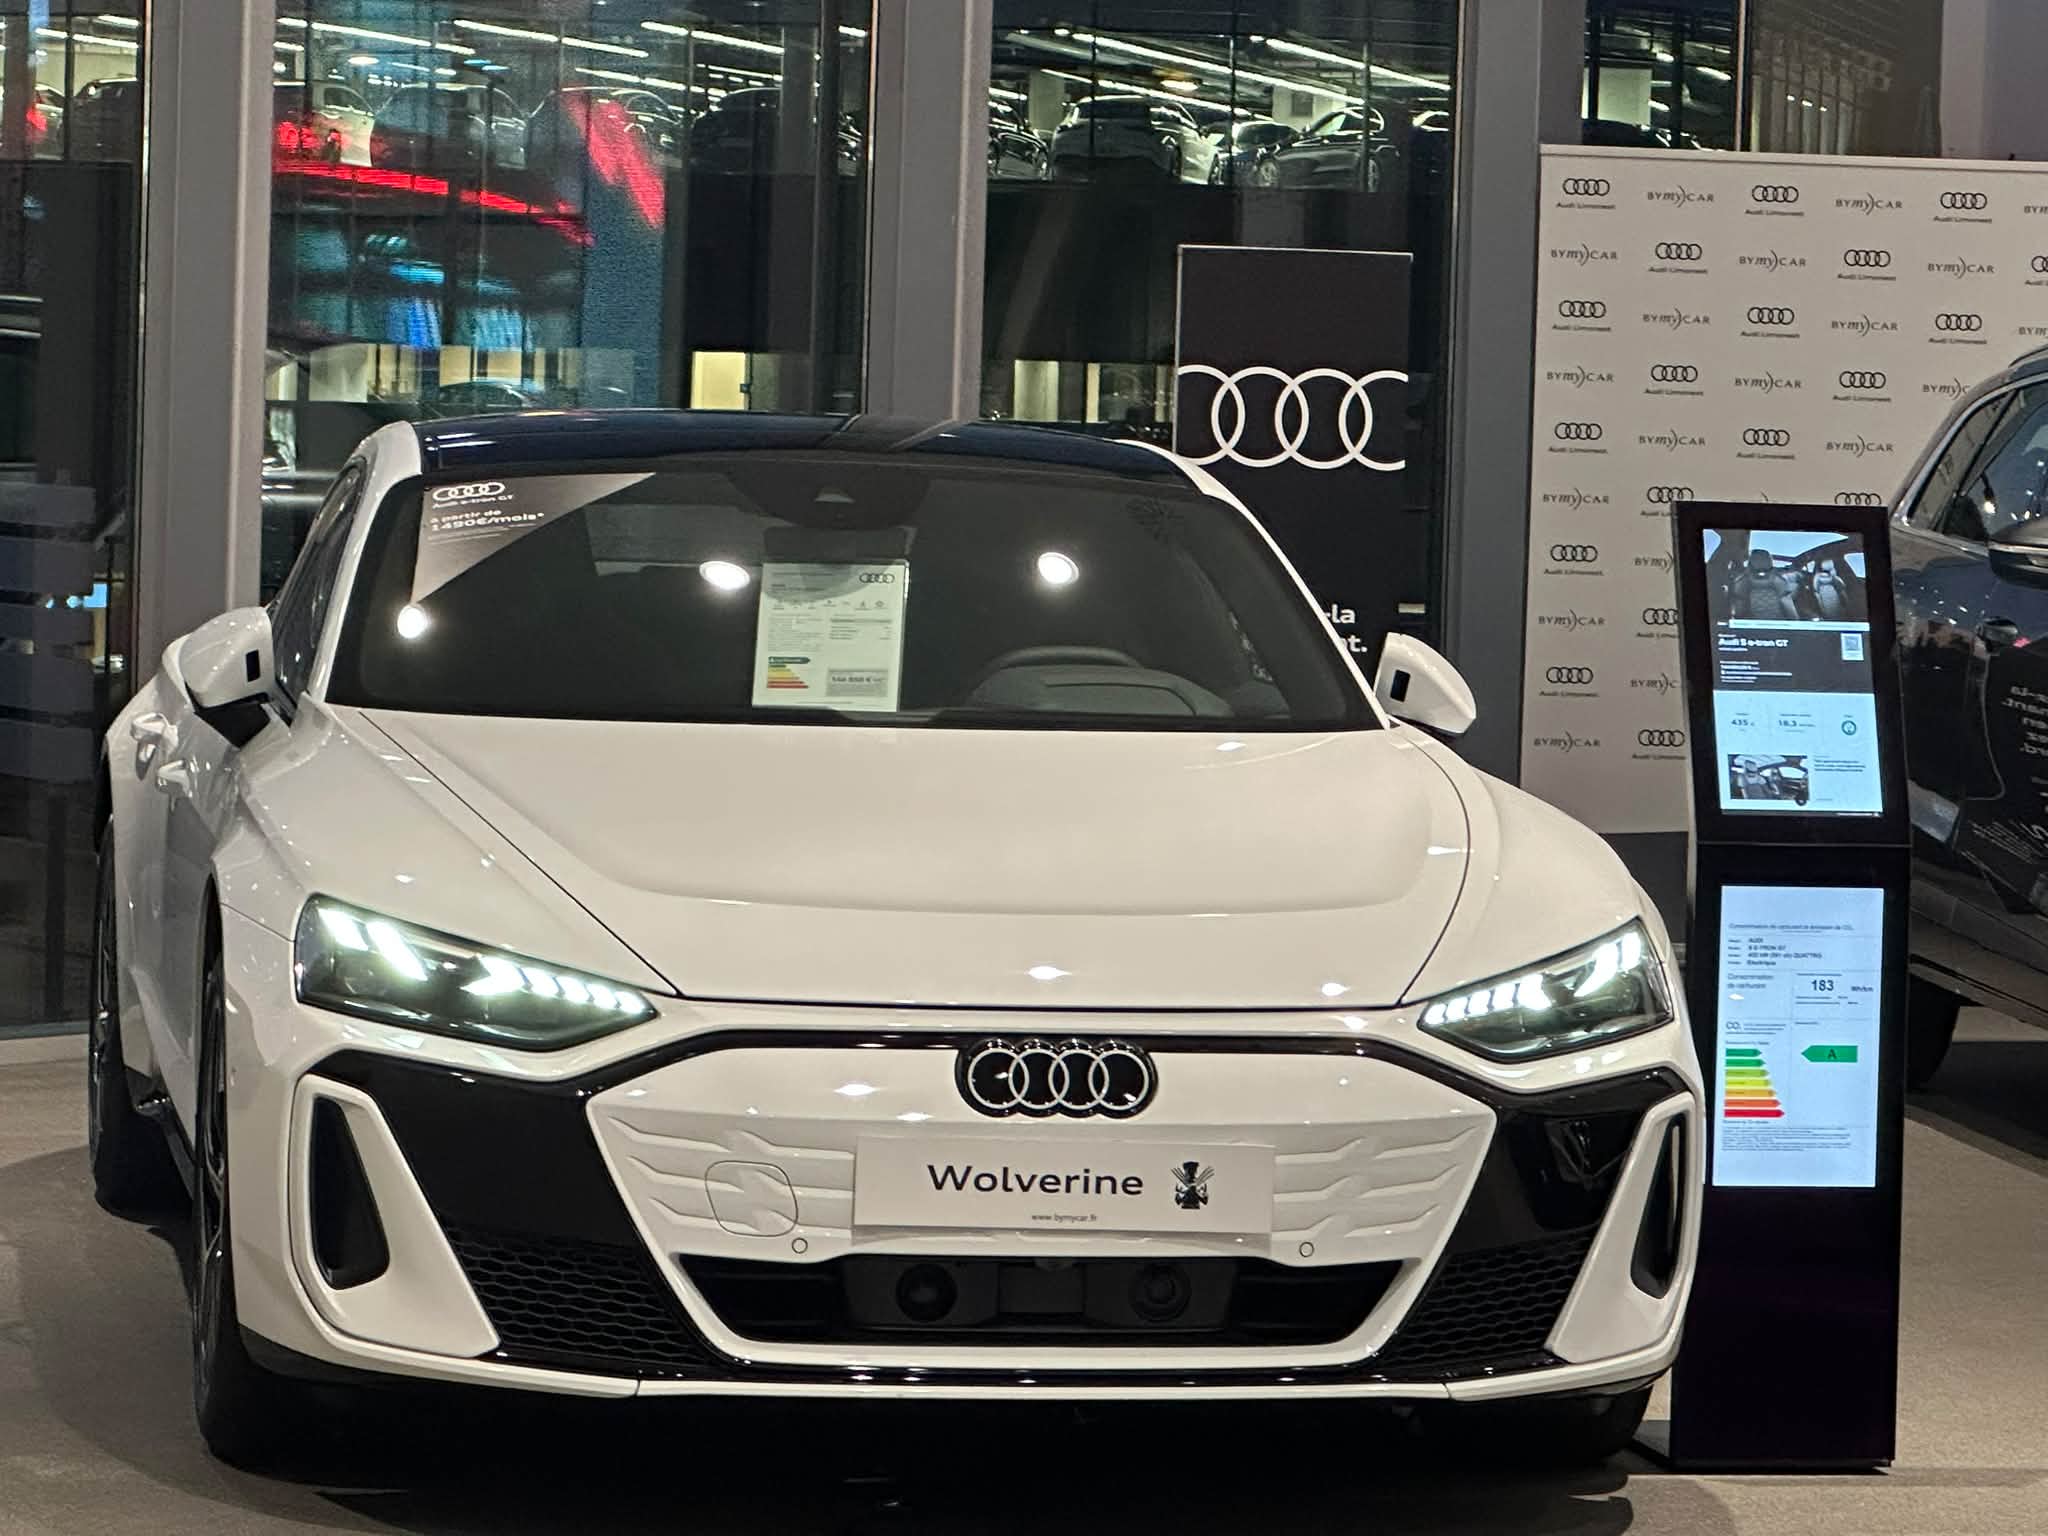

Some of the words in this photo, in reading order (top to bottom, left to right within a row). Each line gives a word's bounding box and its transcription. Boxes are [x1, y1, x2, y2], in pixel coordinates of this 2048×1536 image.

[1811, 979, 1834, 991] 183
[1827, 1049, 1837, 1059] A
[926, 1163, 1144, 1196] Wolverine
